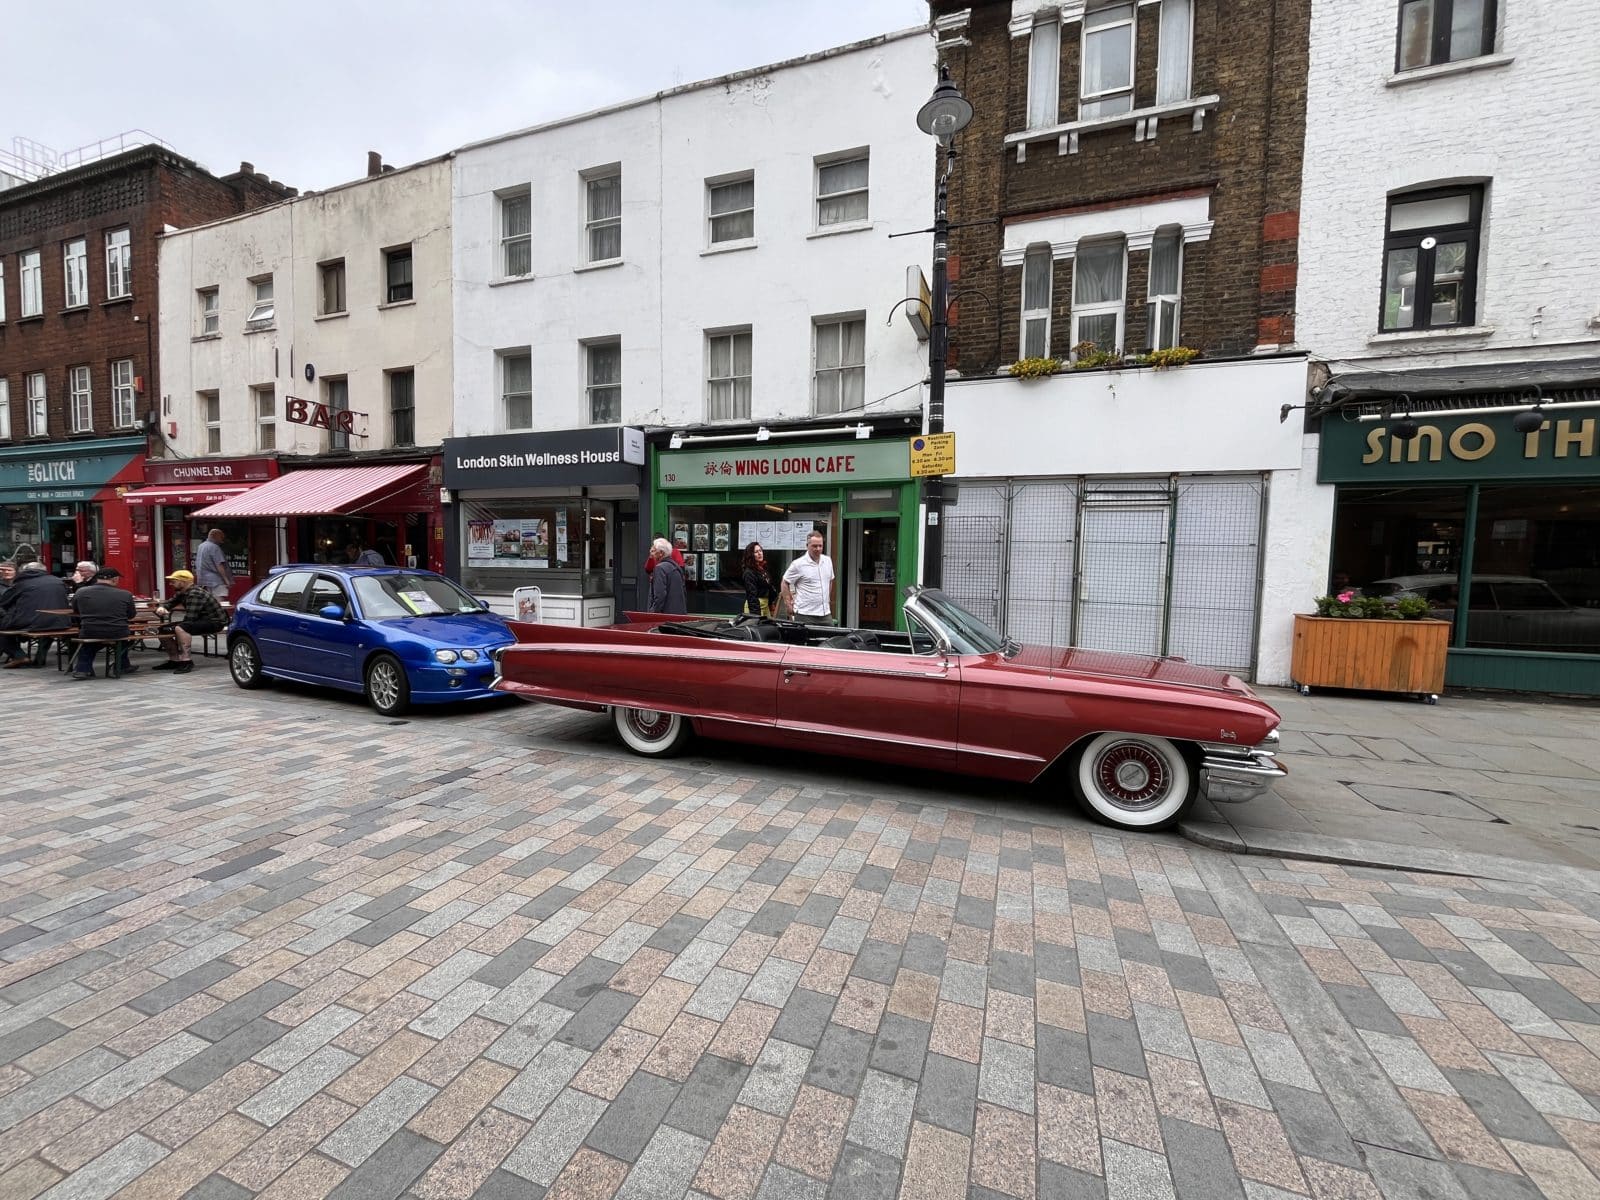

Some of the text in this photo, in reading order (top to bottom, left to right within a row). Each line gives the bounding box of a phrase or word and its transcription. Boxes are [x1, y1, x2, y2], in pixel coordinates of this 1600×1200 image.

[287, 399, 354, 434] BAR
[1363, 422, 1496, 464] SINO
[456, 450, 620, 469] London Skin Wellness House
[735, 455, 855, 476] WING LOON CAFE
[35, 461, 75, 482] GLITCH
[173, 465, 232, 478] CHUNNEL BAR
[664, 473, 676, 482] 130
